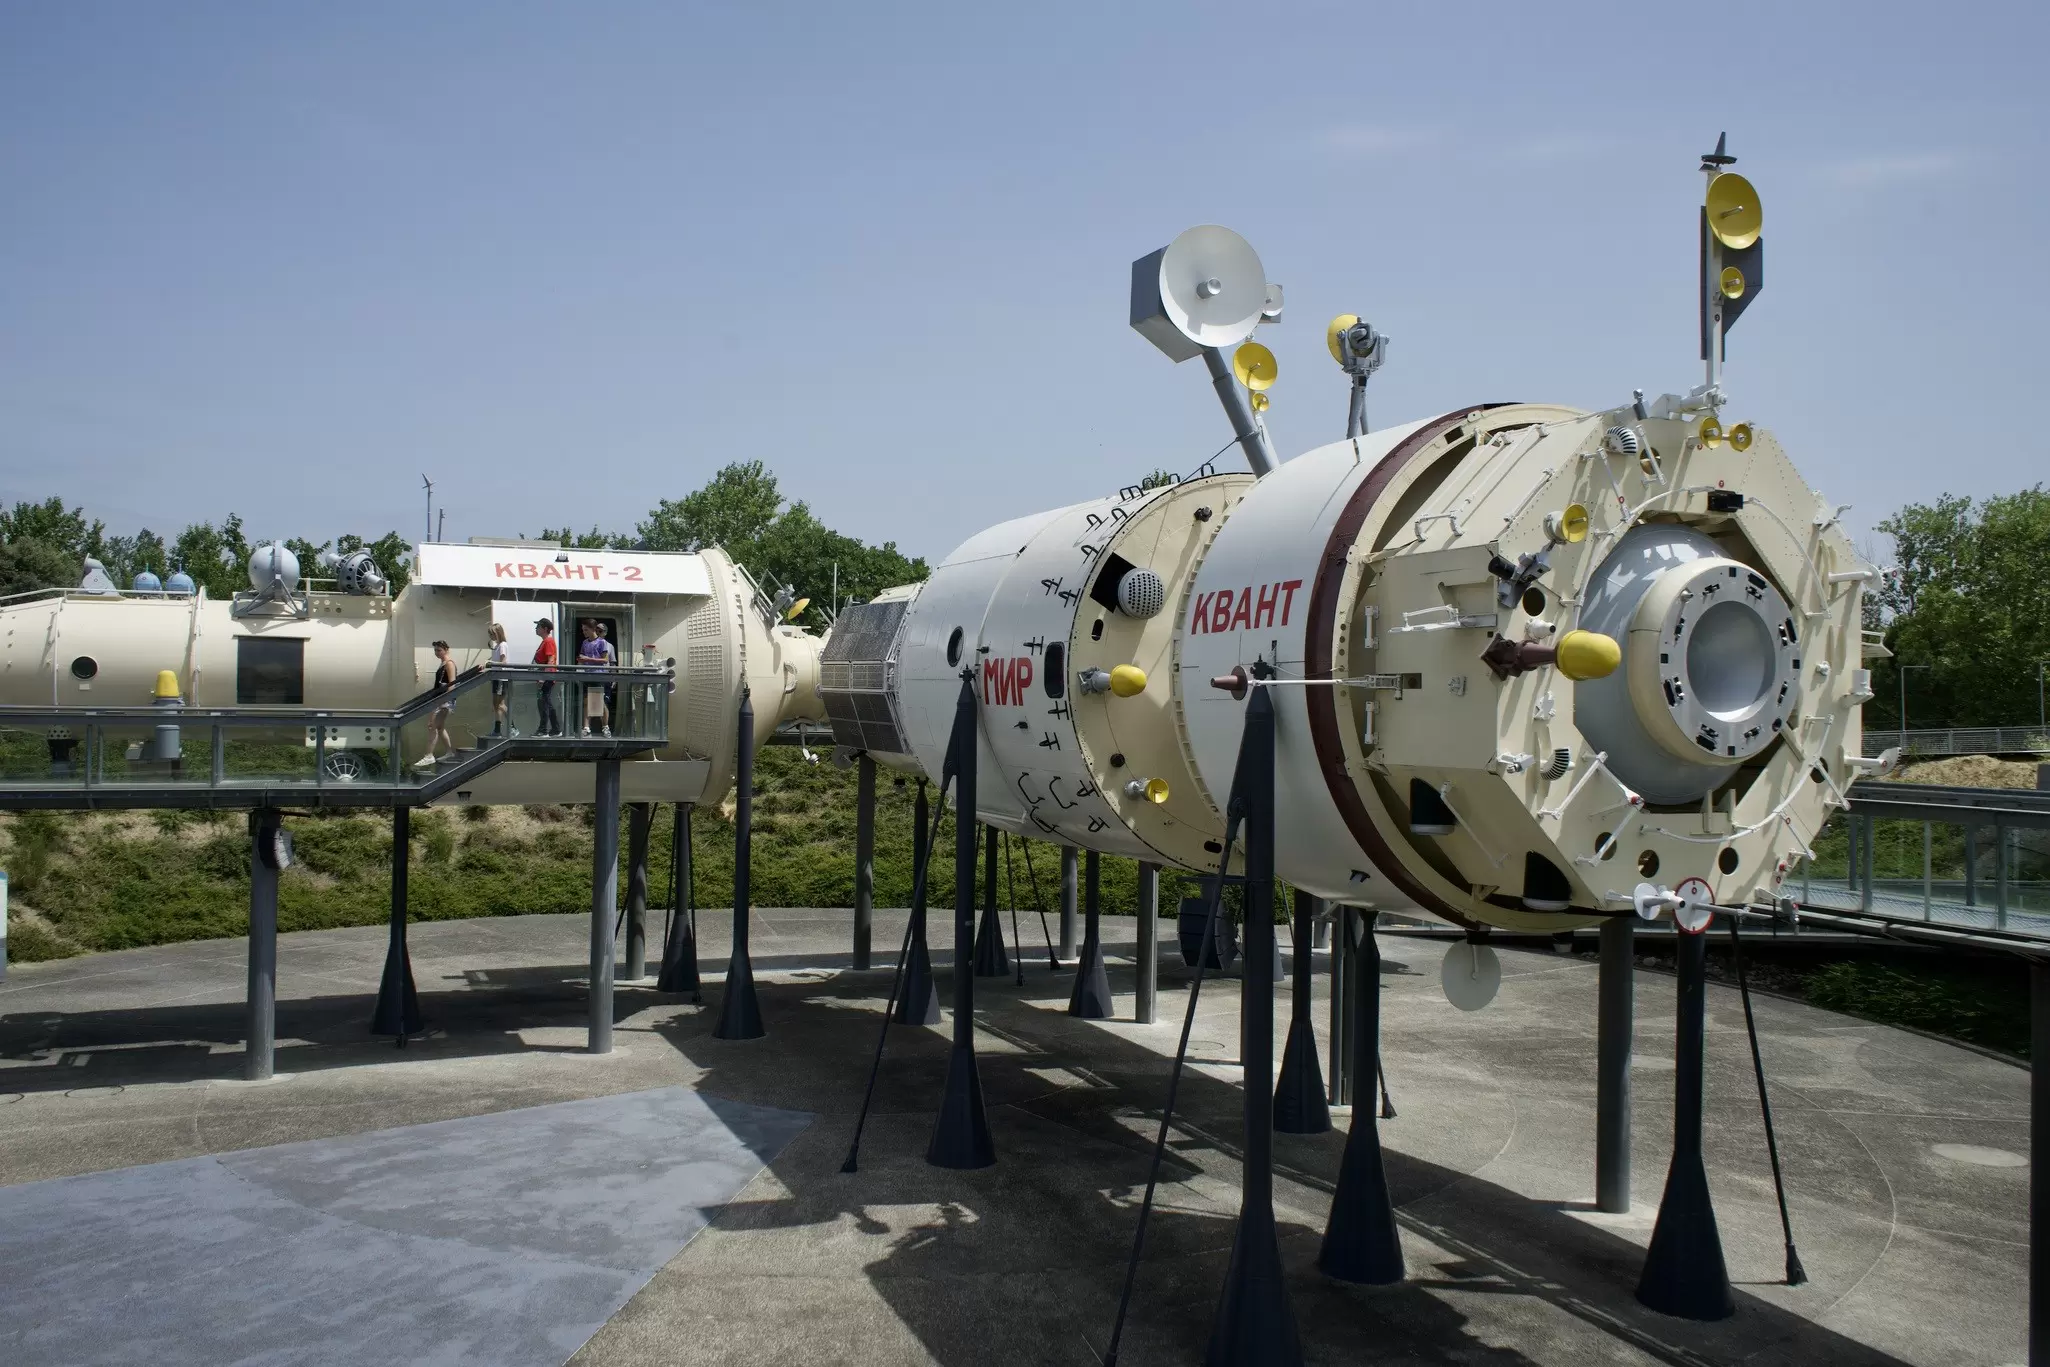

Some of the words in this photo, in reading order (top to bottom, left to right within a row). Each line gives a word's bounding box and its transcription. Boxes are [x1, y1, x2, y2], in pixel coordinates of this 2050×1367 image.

[495, 563, 643, 581] КВАНТ-2
[1191, 579, 1303, 635] КВАНТ
[984, 657, 1033, 706] МИР
